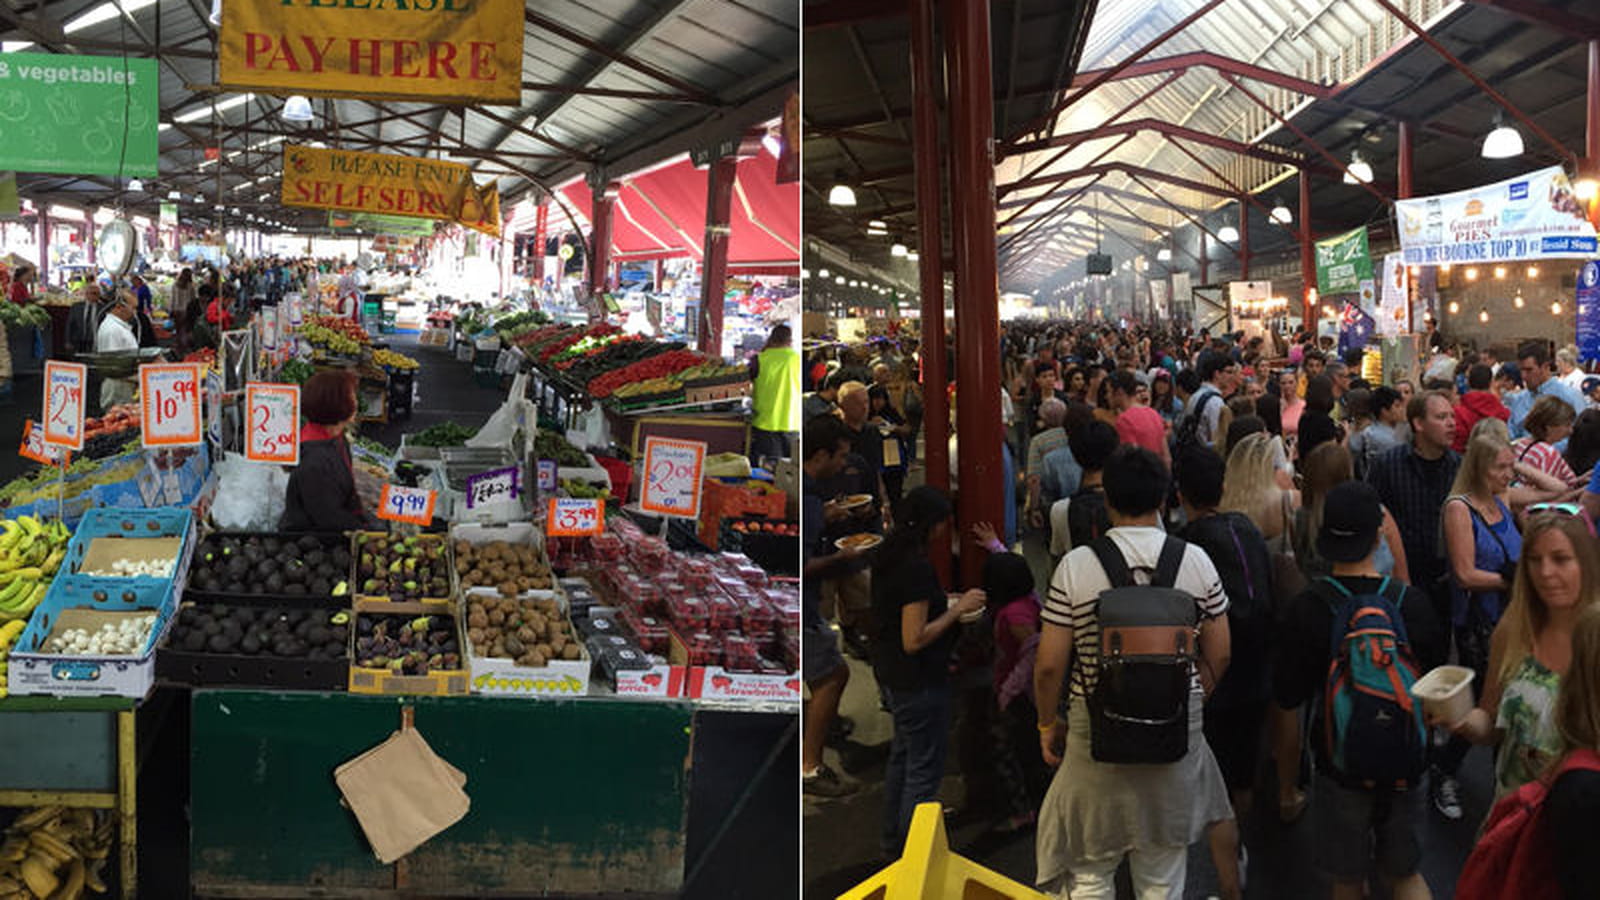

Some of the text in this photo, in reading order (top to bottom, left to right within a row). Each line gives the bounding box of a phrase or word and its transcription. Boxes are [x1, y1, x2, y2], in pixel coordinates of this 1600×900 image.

[244, 31, 497, 81] PAY HERE
[18, 65, 136, 85] vegetables
[330, 154, 407, 177] PLEASE
[293, 178, 374, 210] SELF
[1455, 229, 1492, 243] PIES
[1425, 241, 1487, 263] MELBOURNE
[1490, 239, 1512, 258] TOP
[1516, 238, 1527, 257] 10
[391, 494, 425, 514] 9.99
